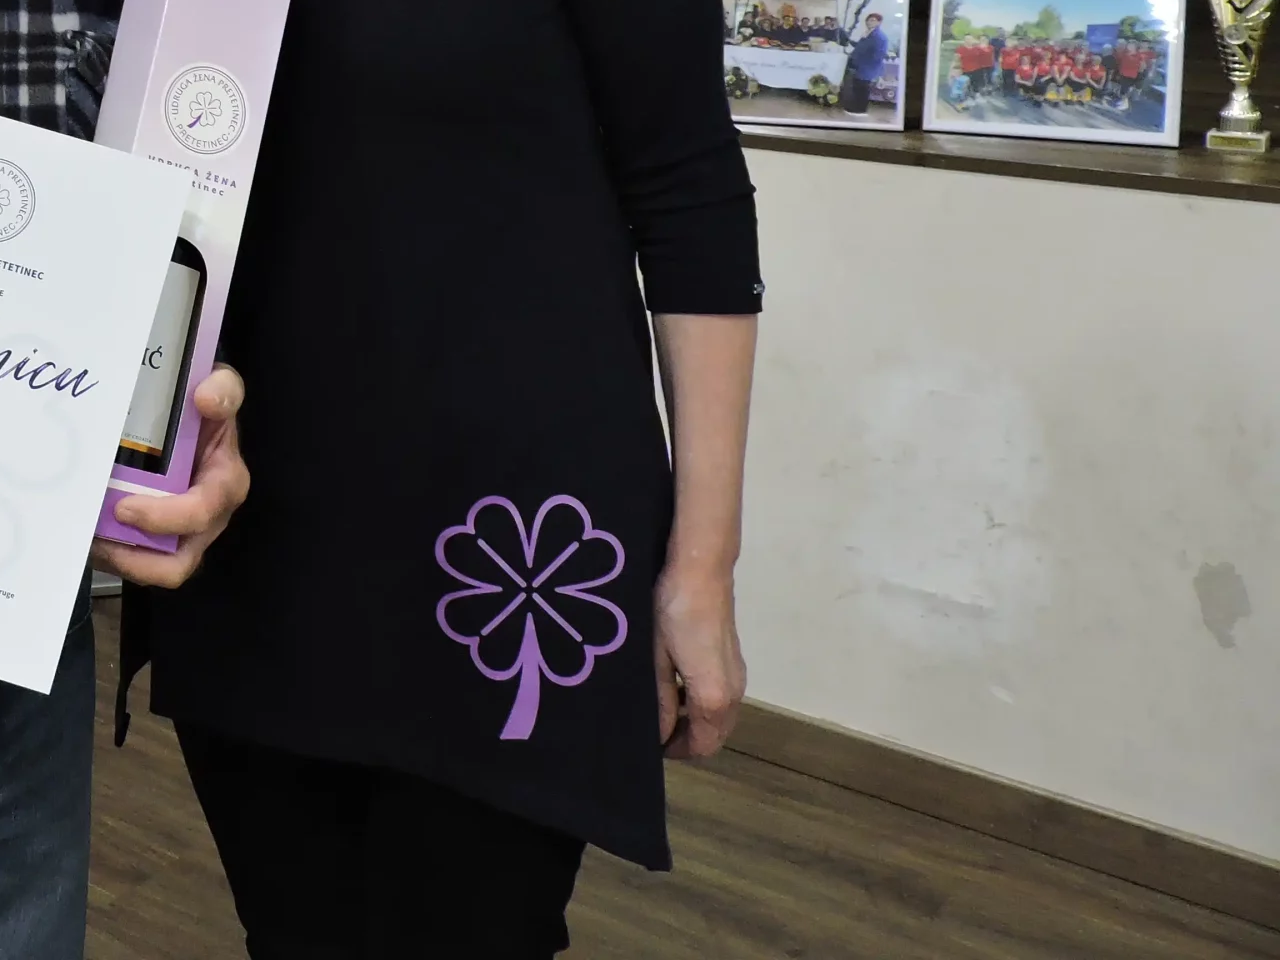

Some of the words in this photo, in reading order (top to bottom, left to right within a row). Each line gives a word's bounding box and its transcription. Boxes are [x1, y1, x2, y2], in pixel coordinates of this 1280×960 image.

[171, 78, 193, 115] UDRUGA
[193, 73, 216, 84] ŽENA
[217, 79, 240, 132] PRETETINEC
[176, 123, 229, 149] PRETETINEC
[7, 169, 29, 222] PRETETINEC
[205, 170, 237, 189] ŽENA
